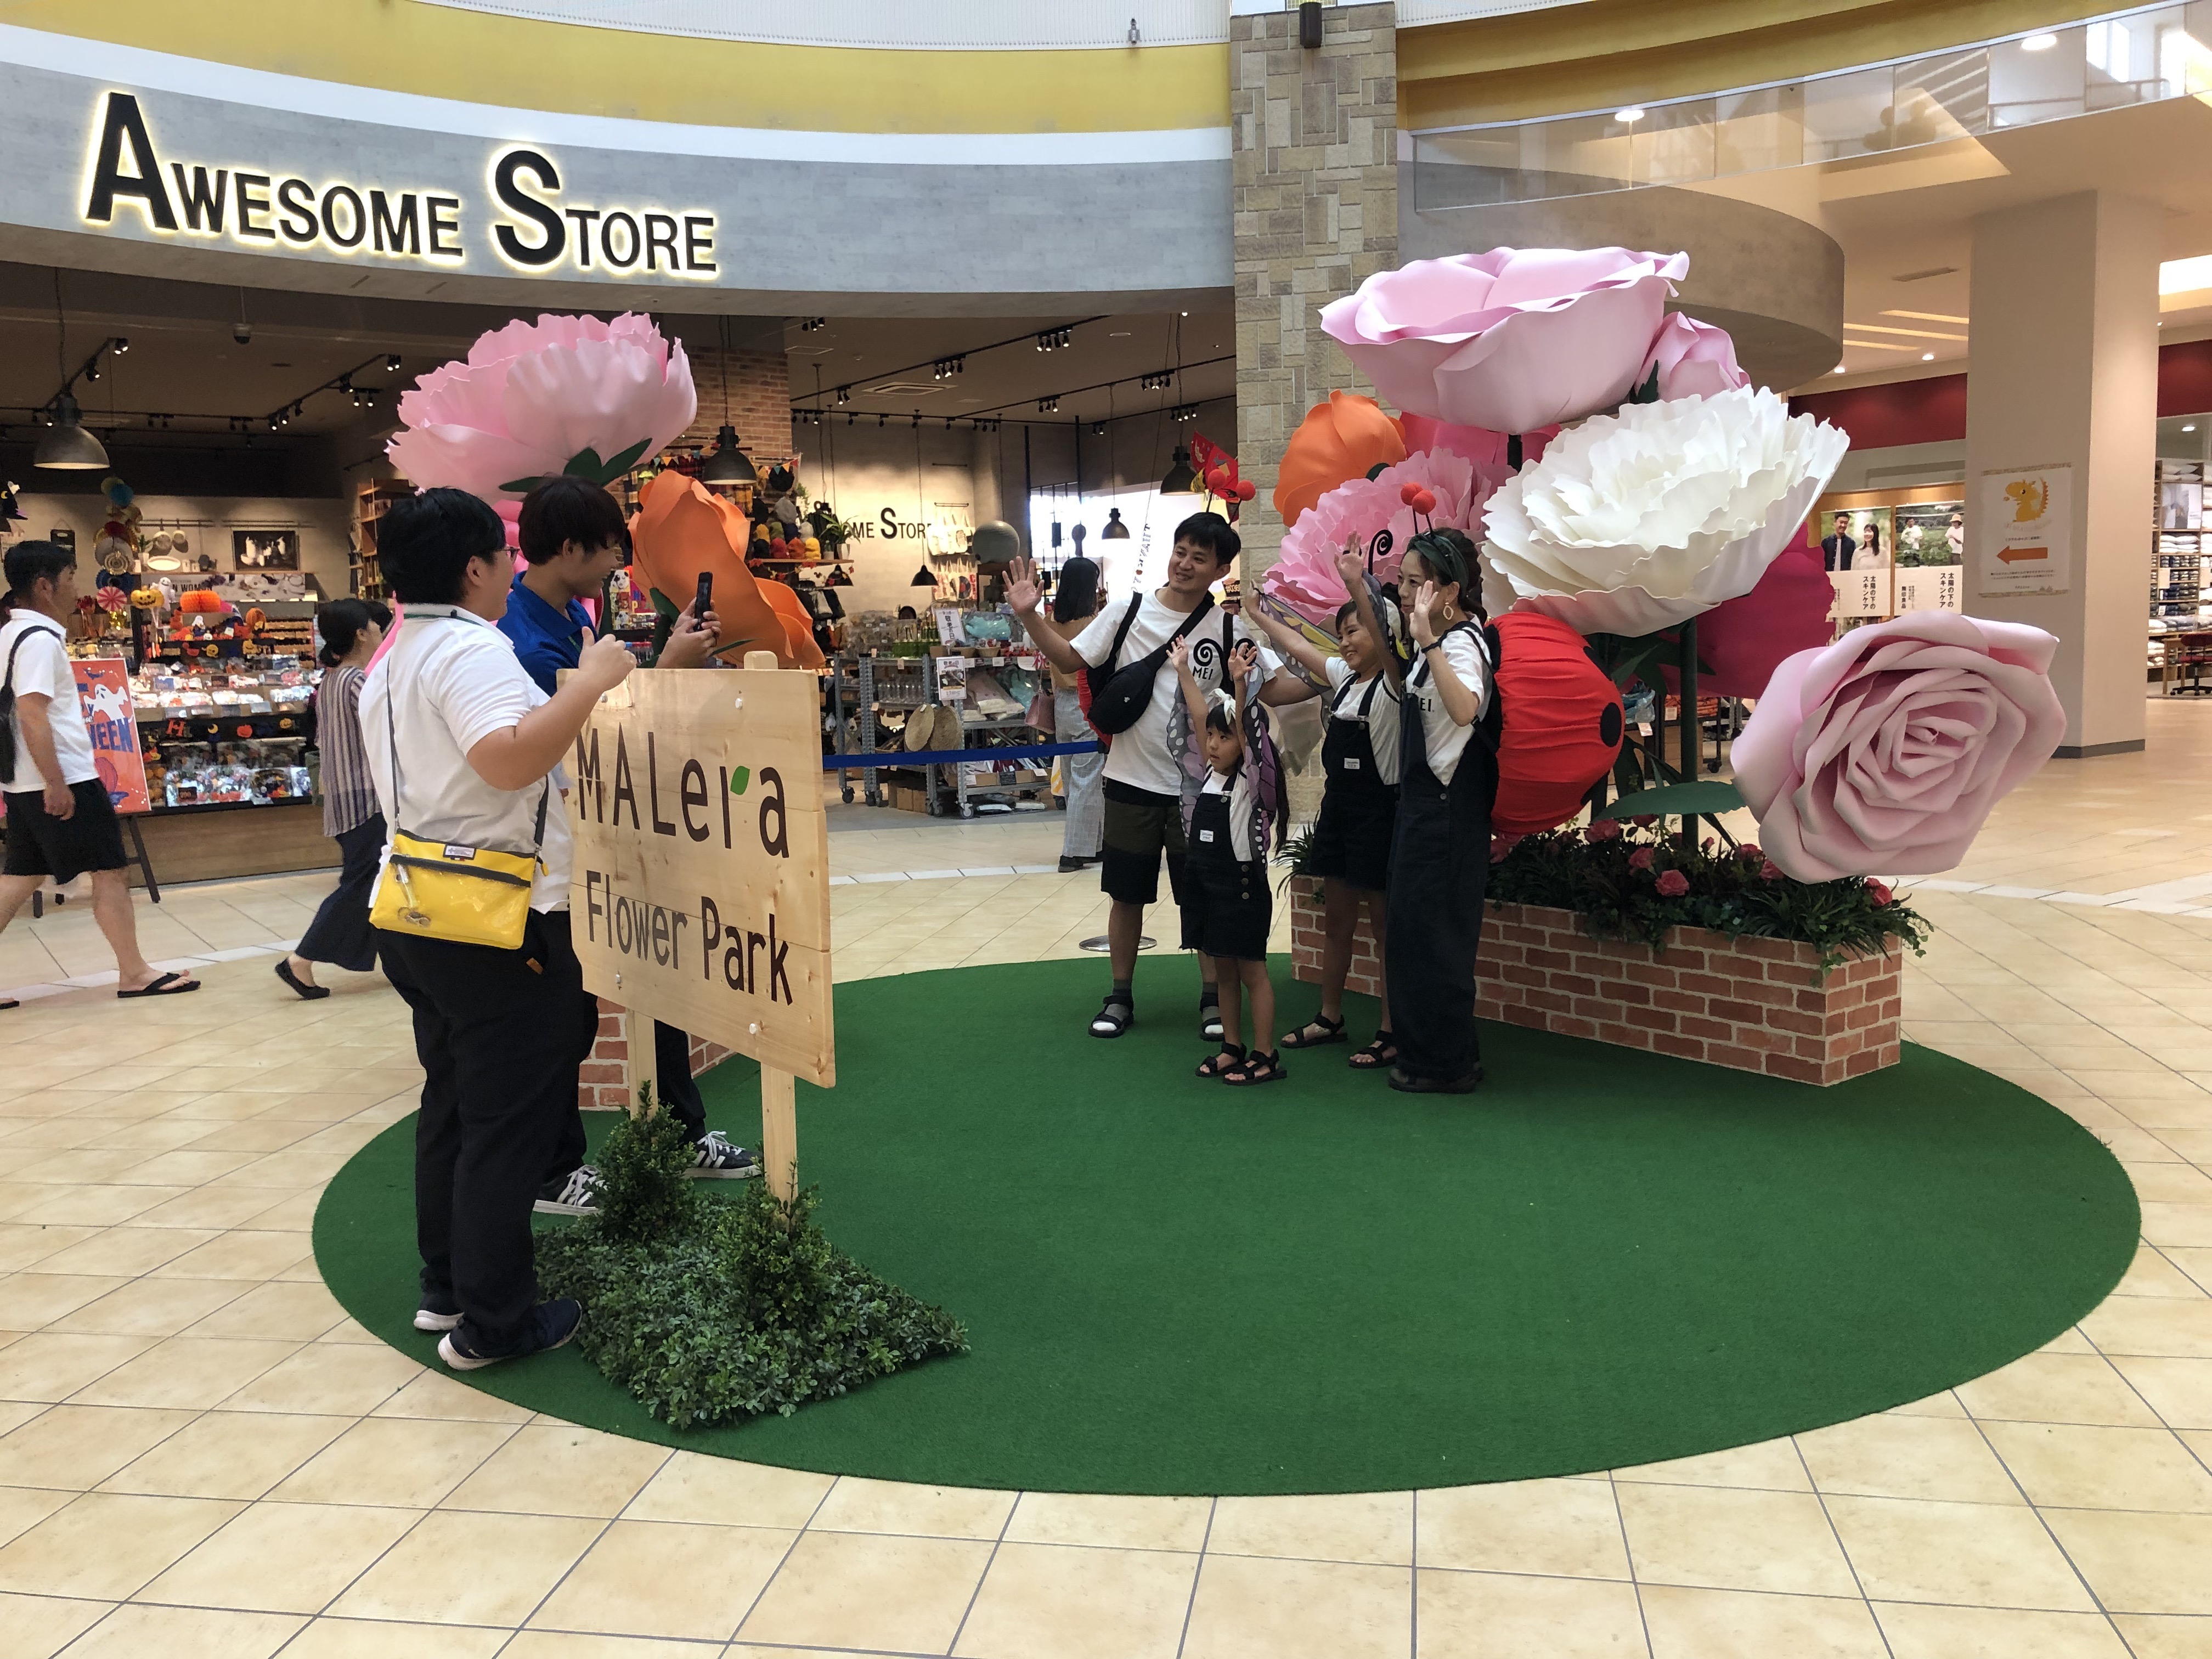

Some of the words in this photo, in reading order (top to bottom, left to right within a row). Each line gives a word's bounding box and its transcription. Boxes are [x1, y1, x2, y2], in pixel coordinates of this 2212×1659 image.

[86, 92, 463, 257] AWESOME
[494, 150, 716, 272] STORE
[881, 507, 932, 539] STOR
[1193, 665, 1214, 680] MEI
[1420, 697, 1432, 712] EI
[577, 722, 789, 858] MALera
[586, 870, 687, 969] Flower
[701, 896, 793, 1006] Park
